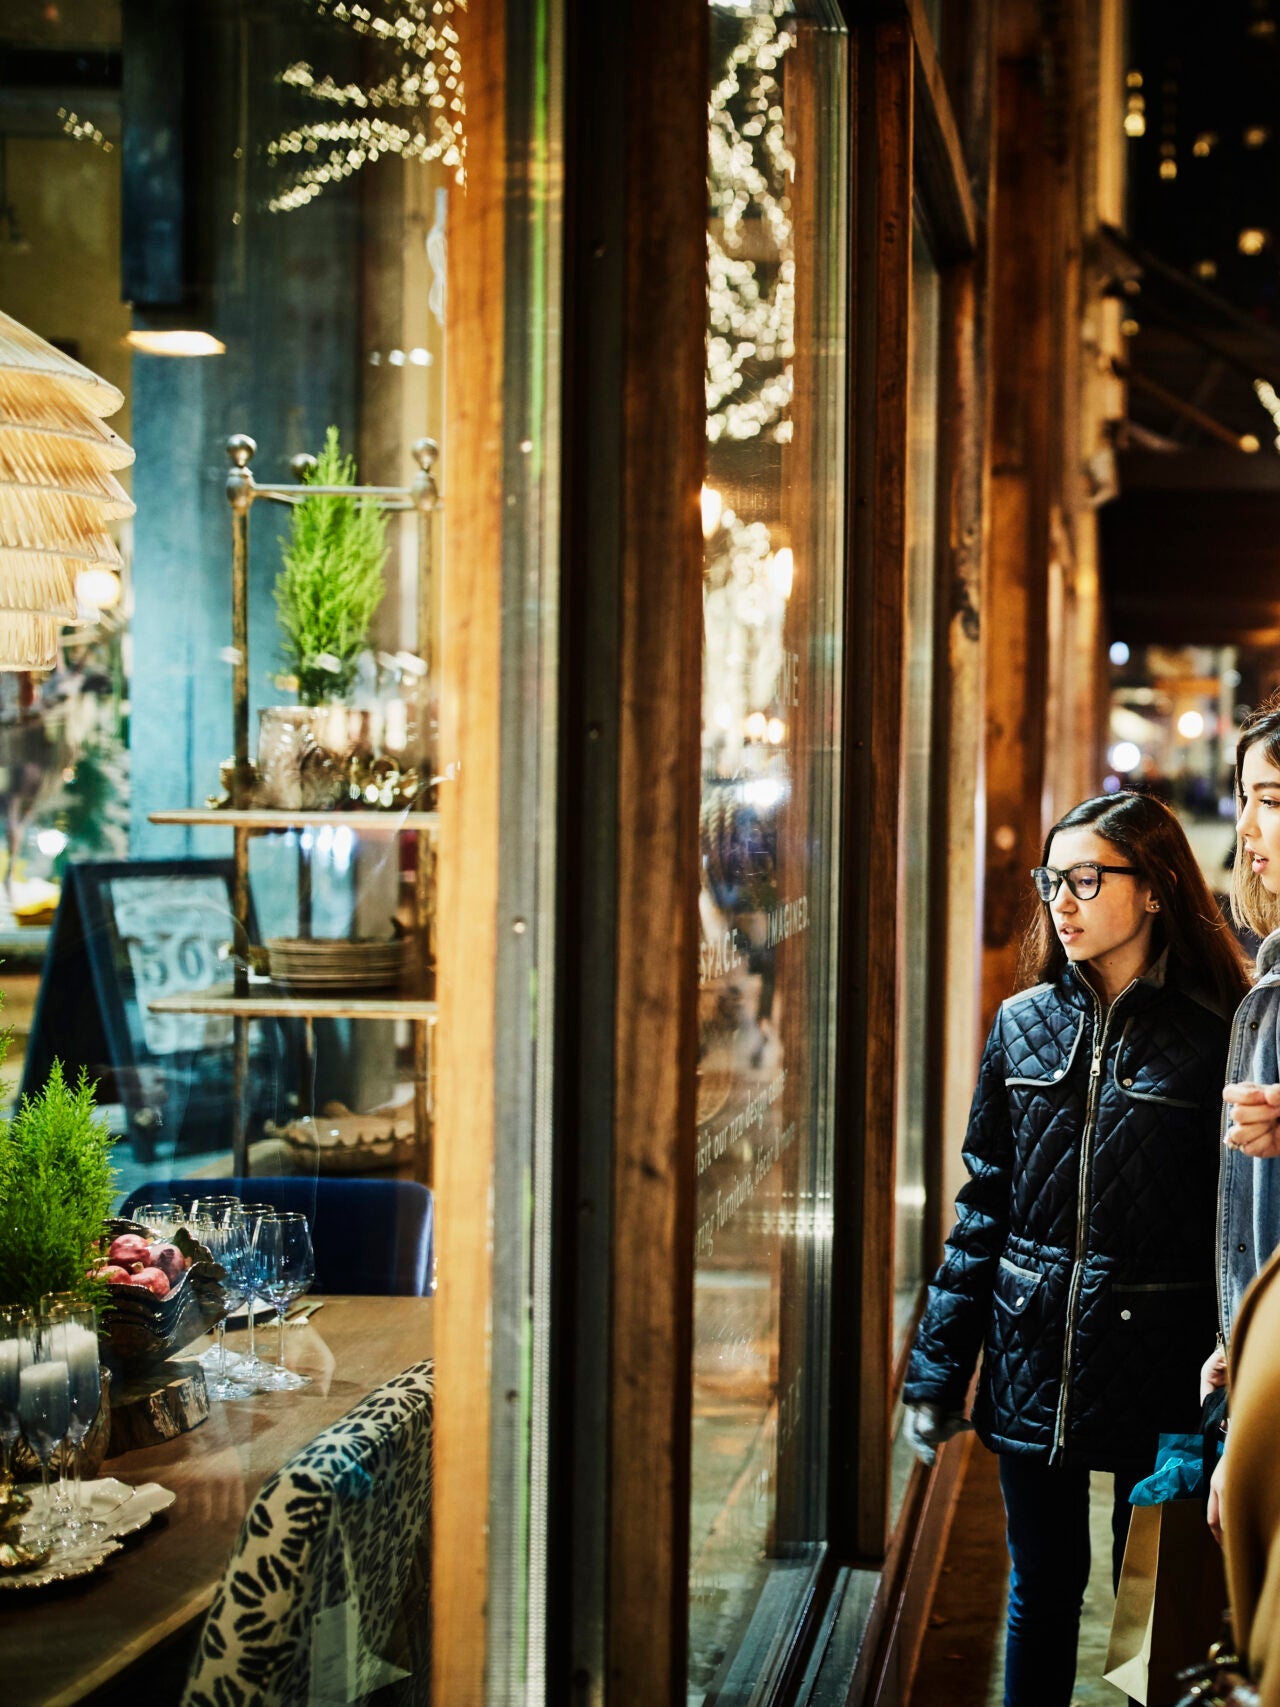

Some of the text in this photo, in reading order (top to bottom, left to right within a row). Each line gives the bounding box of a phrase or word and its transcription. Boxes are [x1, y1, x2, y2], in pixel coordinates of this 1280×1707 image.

[699, 895, 810, 985] SPACE. IMAGINED.
[695, 1129, 712, 1177] isit
[714, 1126, 729, 1160] our
[745, 1084, 768, 1131] design
